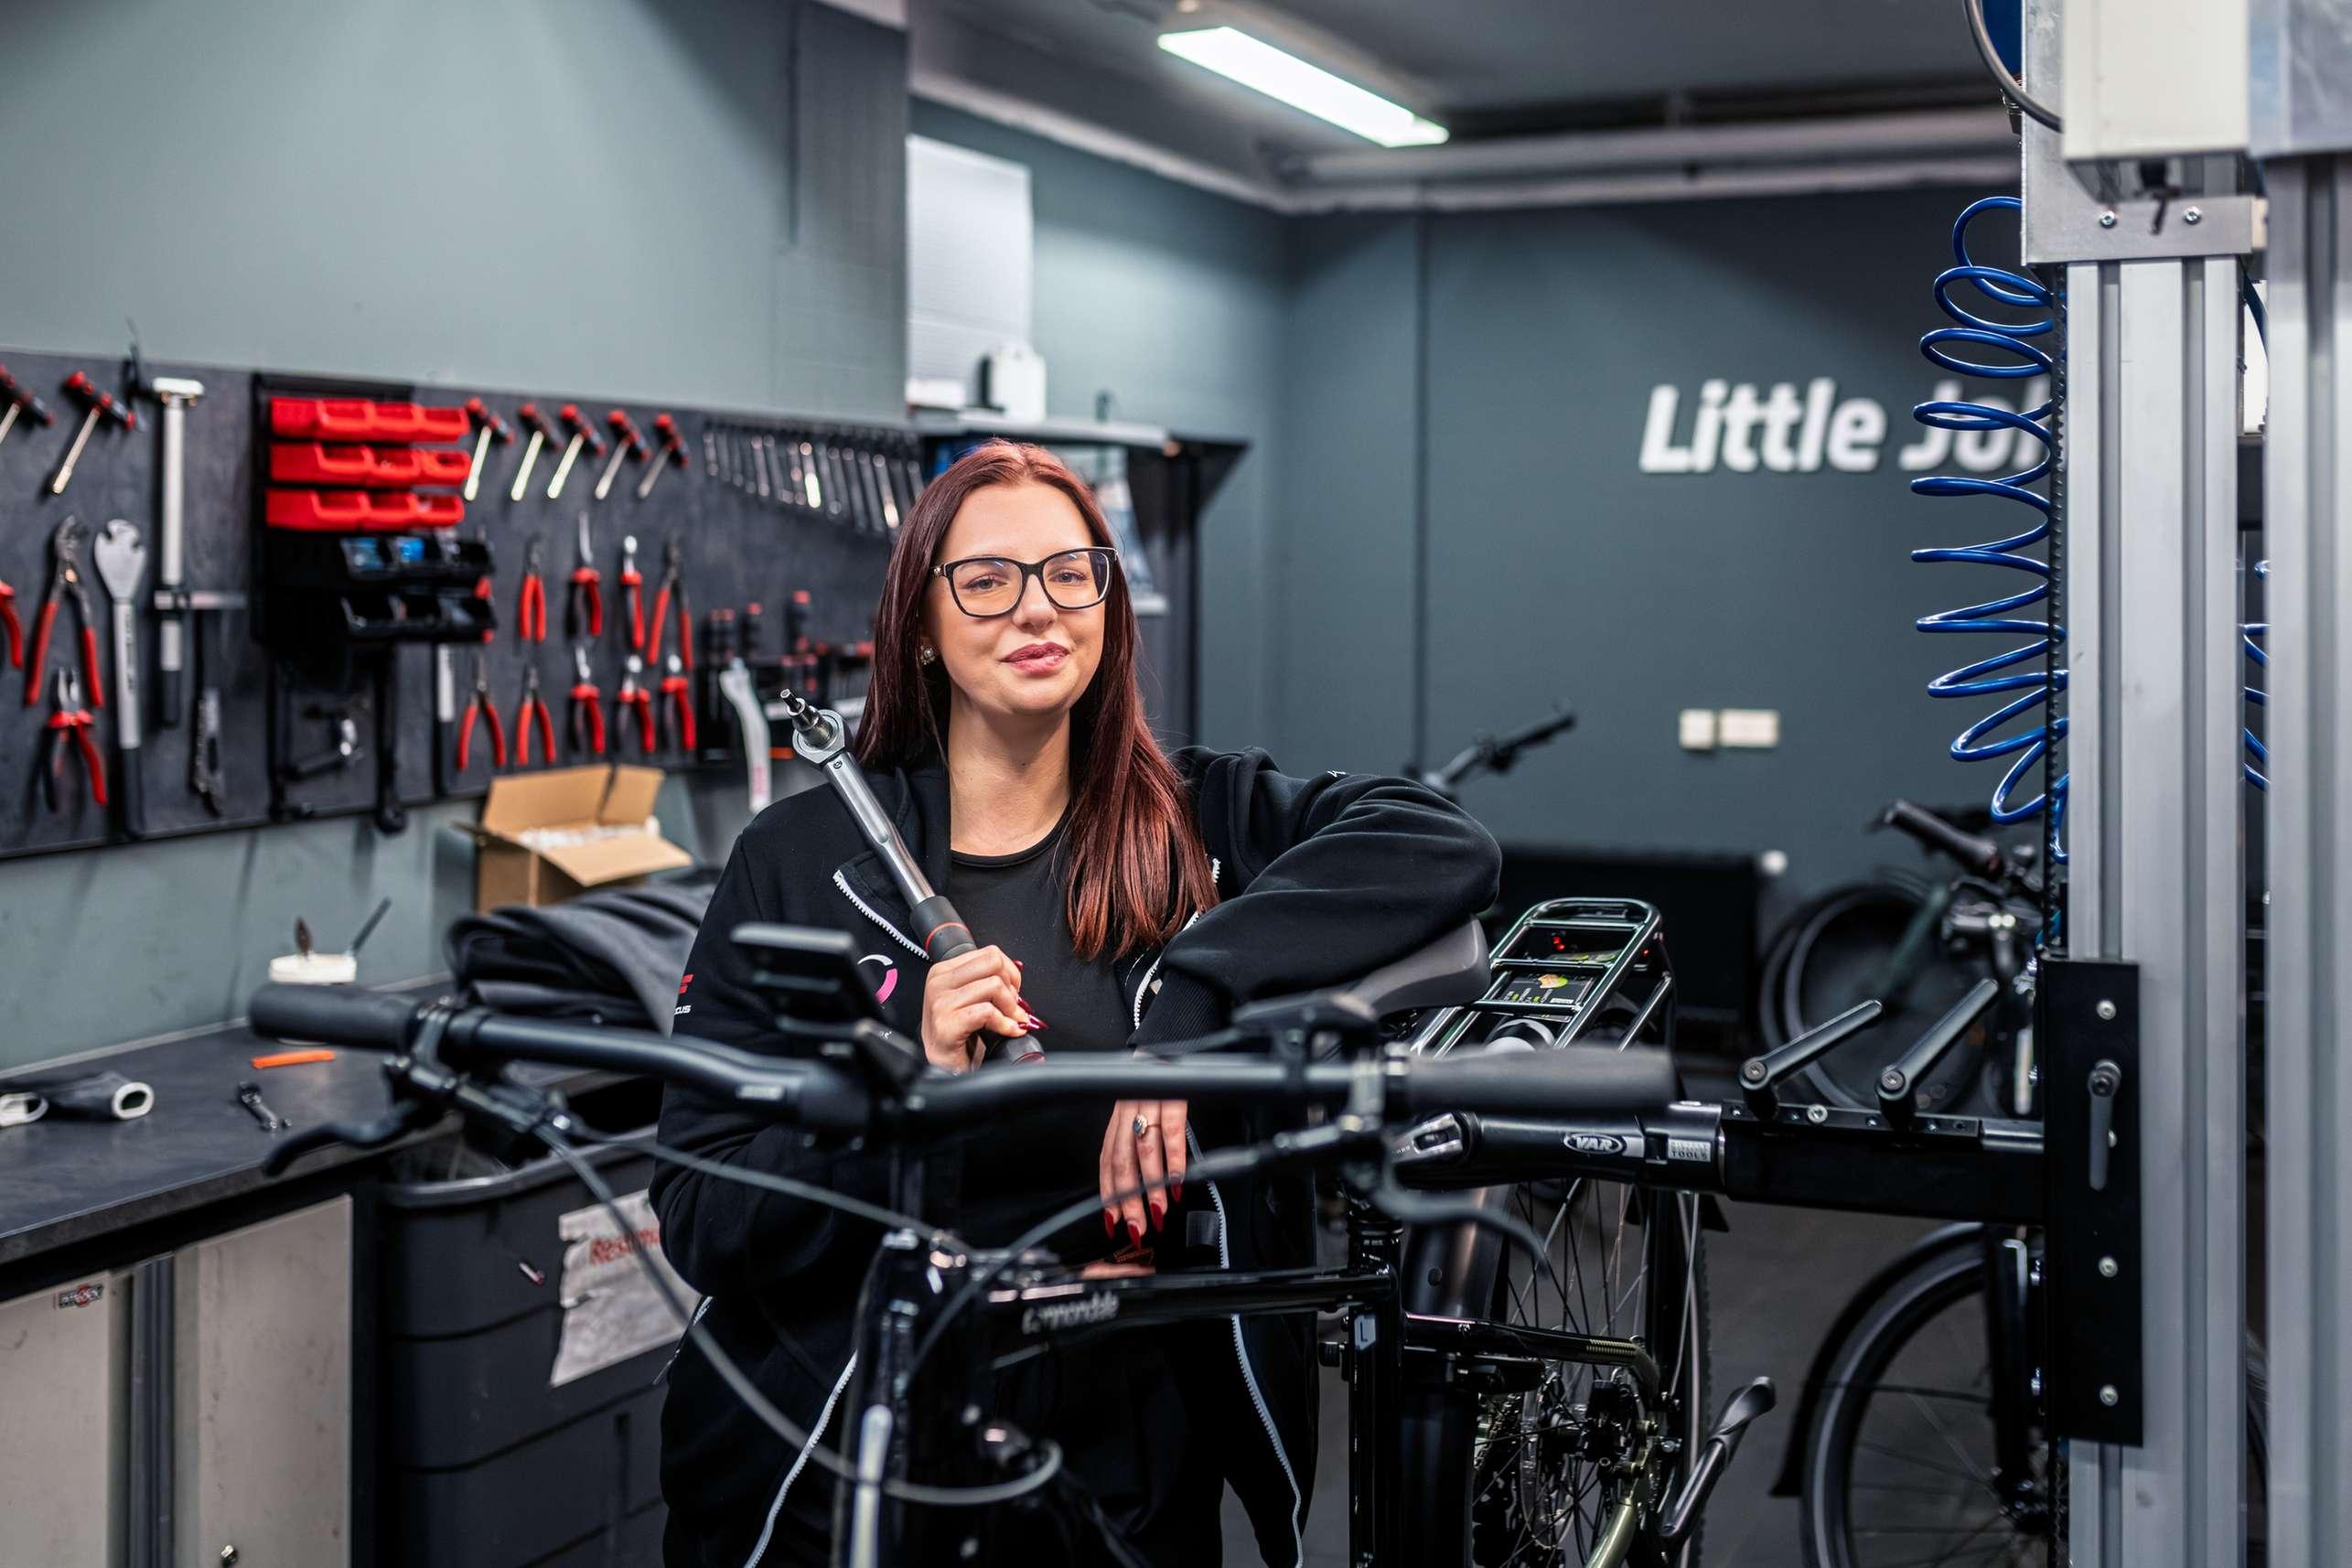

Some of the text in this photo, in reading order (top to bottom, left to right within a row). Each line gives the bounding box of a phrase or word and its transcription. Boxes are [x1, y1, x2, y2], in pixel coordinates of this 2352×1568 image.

[1639, 377, 1887, 474] Little
[1576, 1136, 1613, 1151] VAR
[1671, 1150, 1708, 1161] TOOLS
